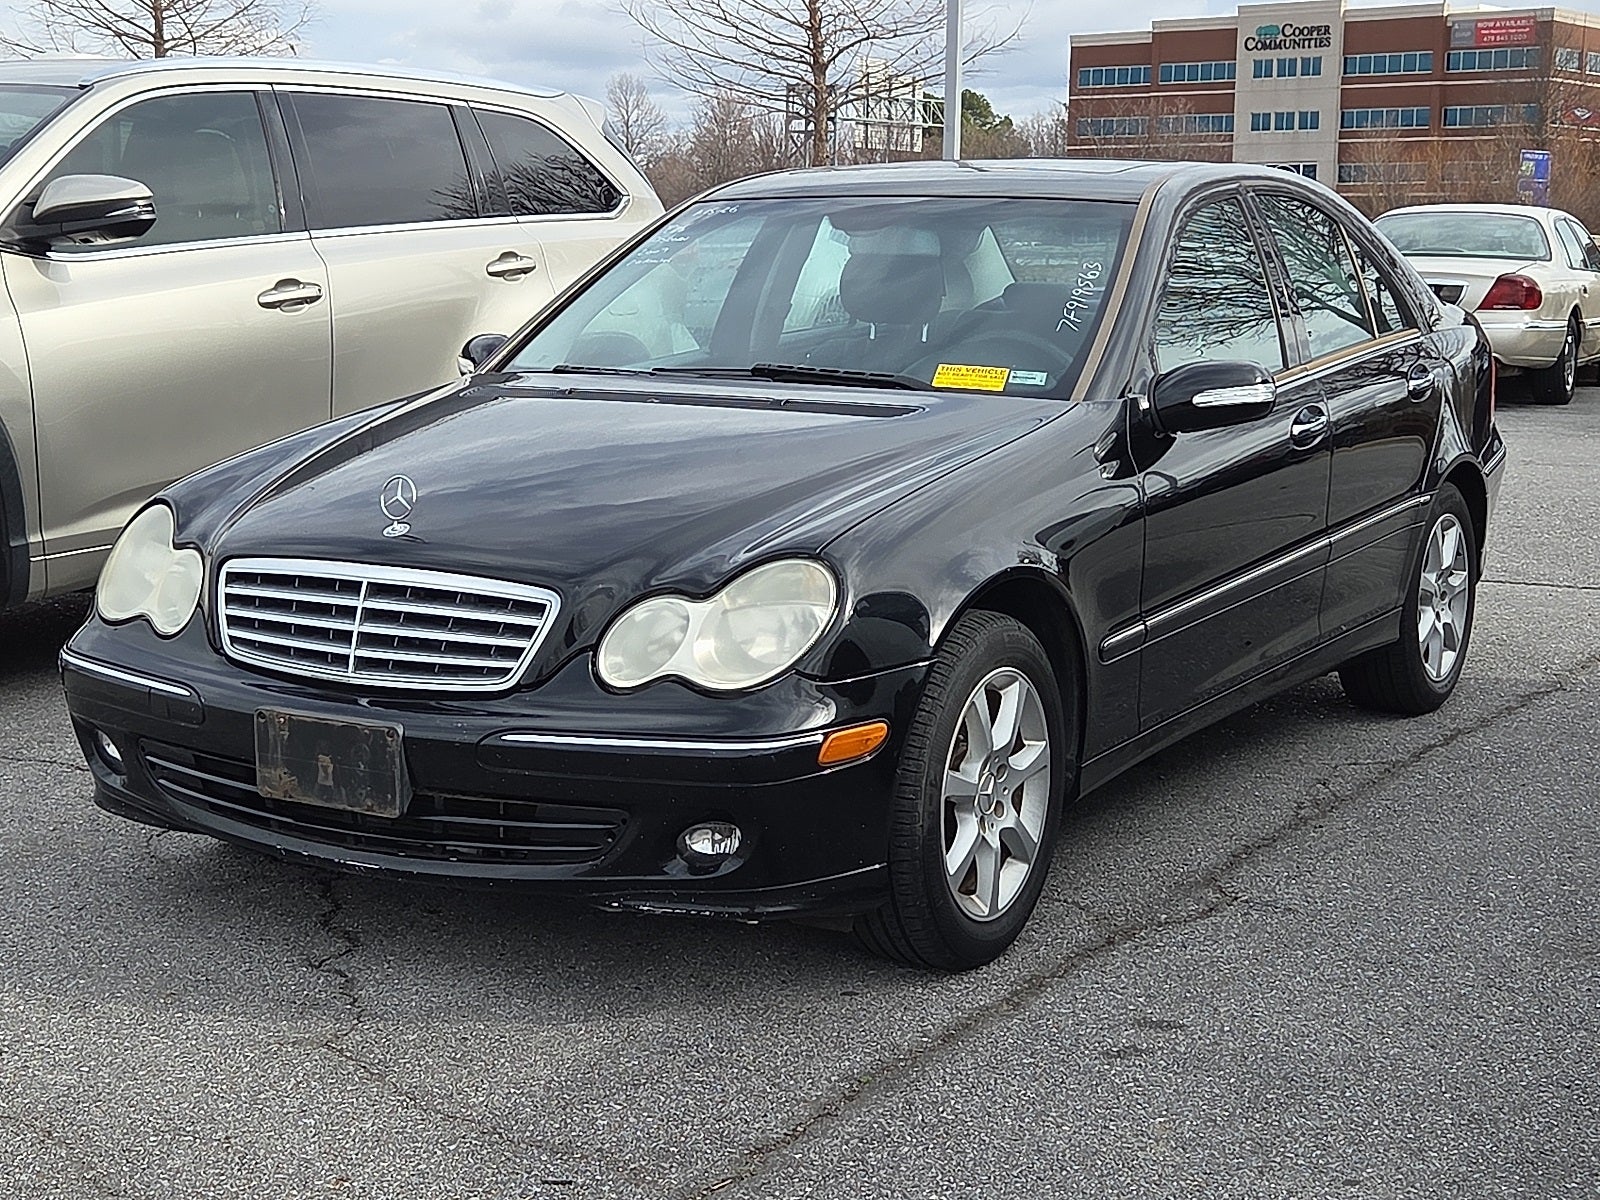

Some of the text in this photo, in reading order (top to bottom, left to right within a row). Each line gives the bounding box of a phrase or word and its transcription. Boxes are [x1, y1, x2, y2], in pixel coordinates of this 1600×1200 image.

[1281, 23, 1331, 37] COOPER
[1244, 36, 1331, 51] COMMUNITIES
[965, 368, 1007, 376] VEHICLE
